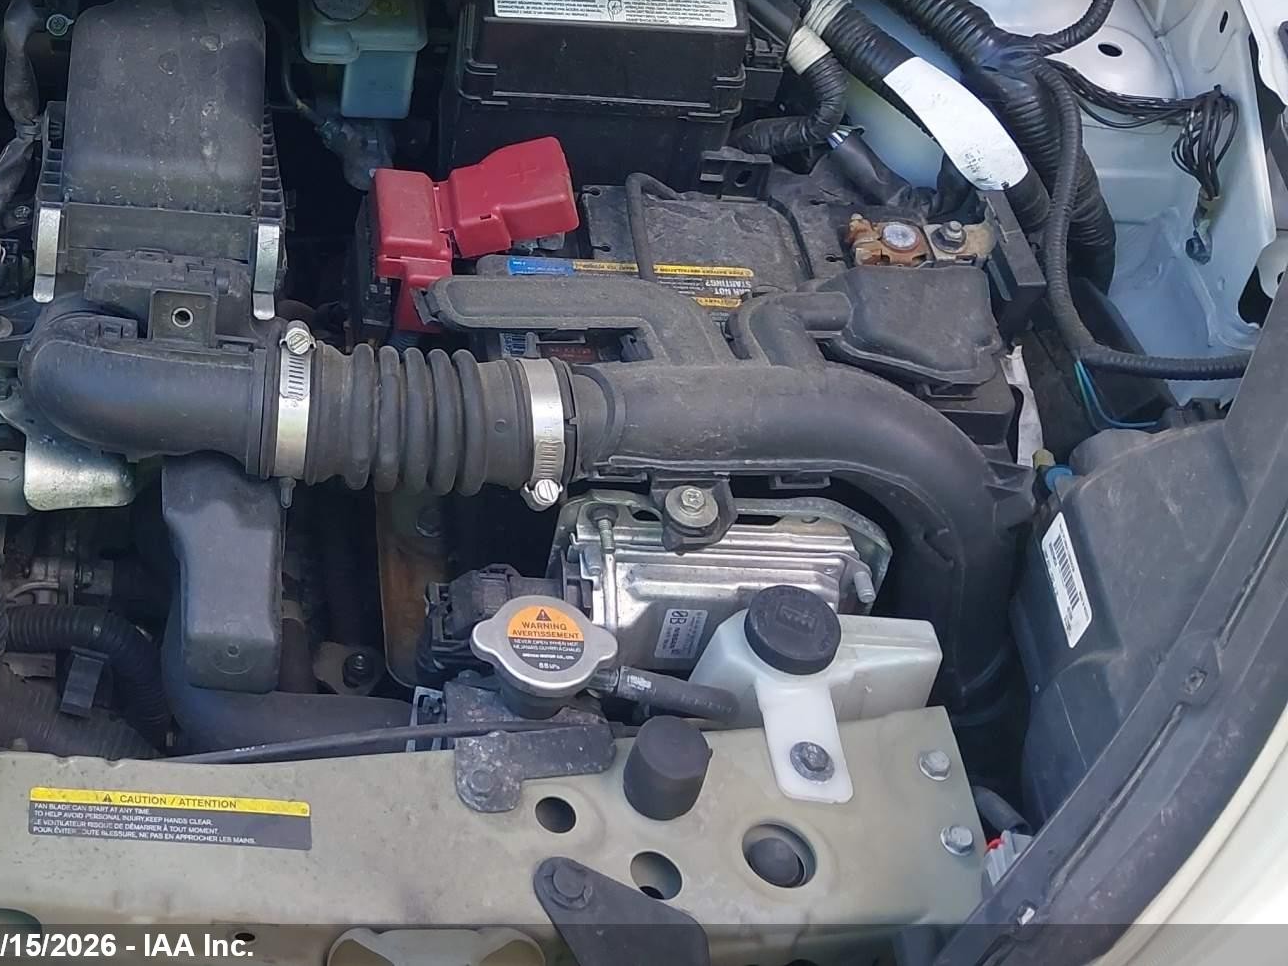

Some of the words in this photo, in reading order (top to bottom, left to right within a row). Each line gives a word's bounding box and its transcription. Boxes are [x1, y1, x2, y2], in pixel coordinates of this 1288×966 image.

[521, 621, 567, 631] WARNING
[512, 629, 580, 639] AVERTISSEMENT
[119, 794, 167, 805] CAUTION
[178, 797, 238, 809] ATTENTION
[34, 802, 48, 810] FAN
[49, 803, 71, 811] BLADE
[72, 804, 87, 812] CAN
[45, 811, 62, 819] HELP
[63, 812, 84, 820] AVOID
[85, 813, 121, 821] PERSONAL
[164, 817, 188, 825] HANDS
[169, 824, 187, 832] TOUT
[150, 831, 163, 839] PAS
[164, 832, 174, 840] EN
[175, 833, 218, 842] APPROCHER
[219, 835, 232, 843] LES
